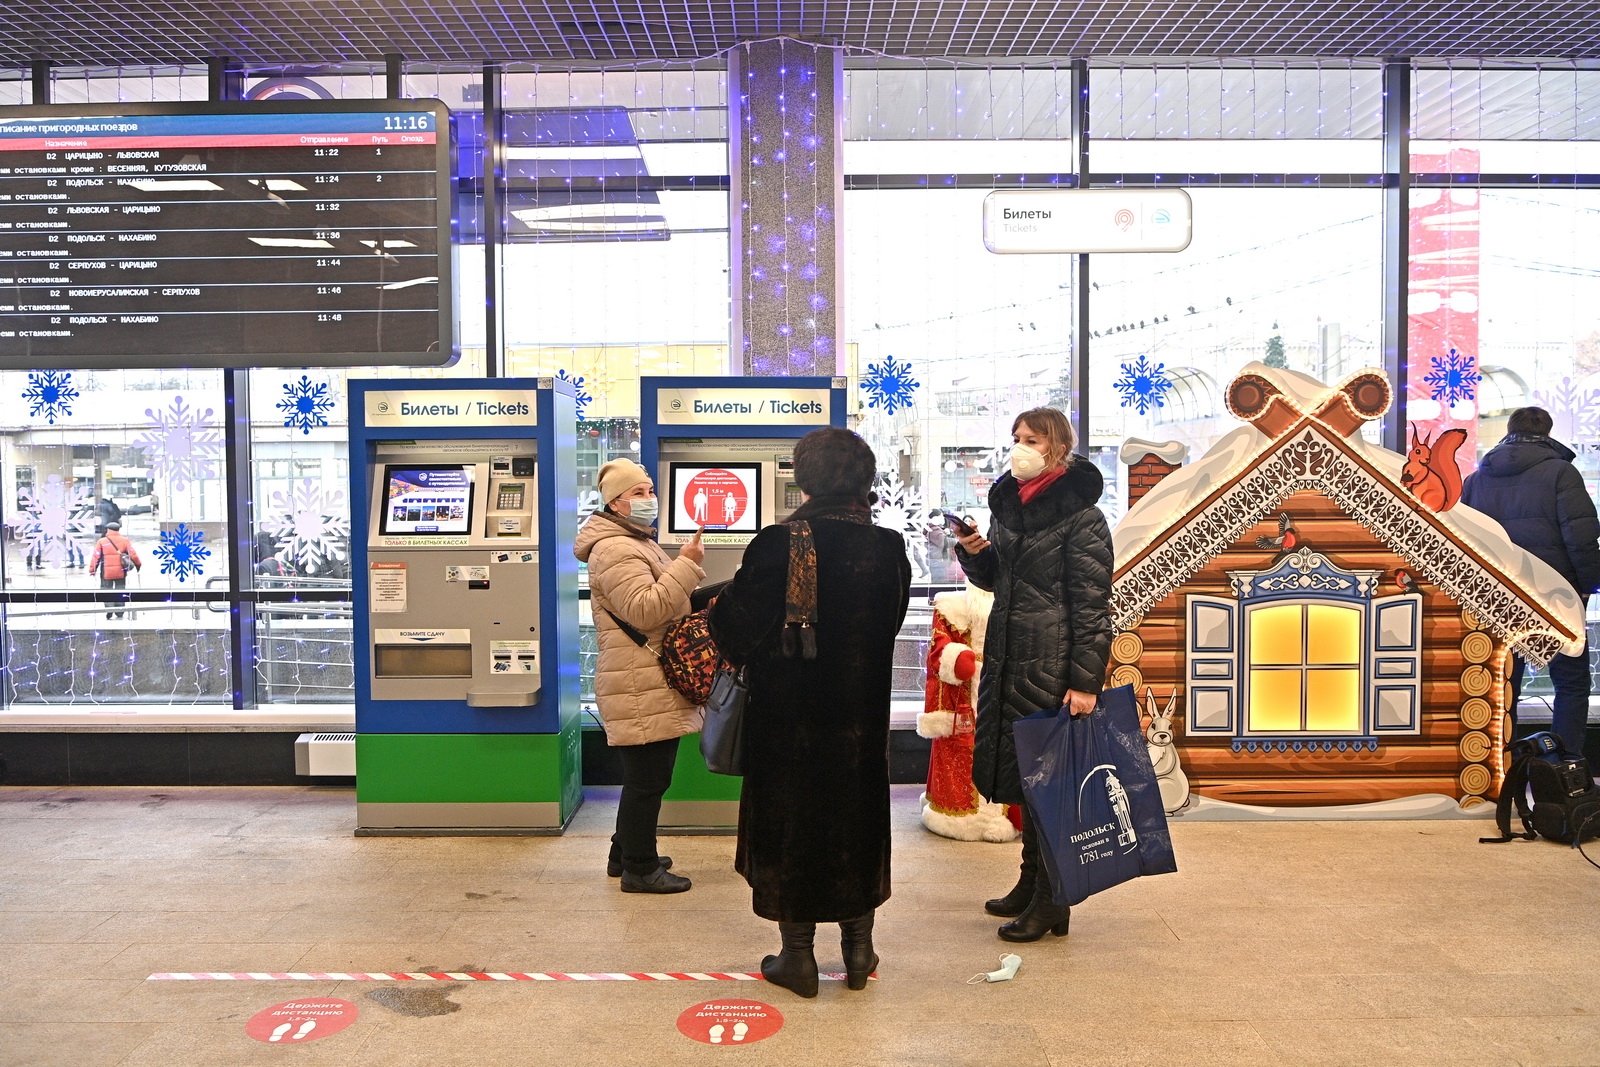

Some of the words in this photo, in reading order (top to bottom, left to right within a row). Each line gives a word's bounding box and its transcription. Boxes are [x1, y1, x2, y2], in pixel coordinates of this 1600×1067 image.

[0, 125, 37, 133] писание
[38, 124, 100, 134] пригородных
[100, 123, 138, 132] поездов
[384, 116, 428, 130] 11:16
[45, 140, 88, 148] Назначение
[300, 136, 349, 145] Отправление
[371, 135, 389, 144] Путь
[401, 135, 425, 143] Опозд.
[65, 152, 104, 161] ЦАРИЦЫНО
[116, 151, 160, 159] ЛЬВОВСКАЯ
[375, 148, 382, 156] 1
[71, 166, 94, 174] кроме
[107, 165, 149, 173] ВЕСЕННЯЯ,
[154, 164, 207, 172] КУТУЗОВСКАЯ
[66, 178, 104, 187] ПОДОЛЬСК
[314, 175, 339, 183] 11:24
[376, 174, 382, 182] 2
[15, 193, 71, 201] остановками.
[66, 206, 109, 214] ЛЬВОВСКАЯ
[122, 206, 161, 214] ЦАРИЦЫНО
[315, 203, 340, 211] 11:32
[1003, 208, 1052, 219] Билеты
[16, 221, 72, 229] остановками.
[1003, 223, 1038, 233] Tickets
[67, 234, 105, 243] ПОДОЛЬСК
[118, 234, 157, 242] НАХАБИНО
[316, 231, 340, 239] 11:36
[17, 249, 72, 257] остановками.
[119, 261, 157, 270] ЦАРИЦЫНО
[316, 259, 341, 267] 11:44
[18, 276, 73, 284] остановками.
[69, 288, 149, 297] НОВОИЕРУСАЛИМСКАЯ
[162, 288, 201, 296] СЕРПУХОВ
[317, 286, 342, 294] 11:46
[69, 316, 108, 325] ПОДОЛЬСК
[120, 316, 159, 324] НАХАБИНО
[317, 314, 342, 322] 11:48
[19, 329, 75, 337] остановками.
[401, 402, 459, 416] Билеты
[465, 402, 472, 415] /
[476, 401, 529, 415] Tickets
[694, 399, 752, 414] Билеты
[758, 400, 765, 414] /
[770, 400, 822, 414] Tickets
[1070, 823, 1115, 843] ПОДОЛЬСК
[1082, 840, 1104, 850] основан
[1079, 849, 1100, 865] 1781
[1101, 850, 1114, 858] году
[284, 1002, 343, 1010] Держите
